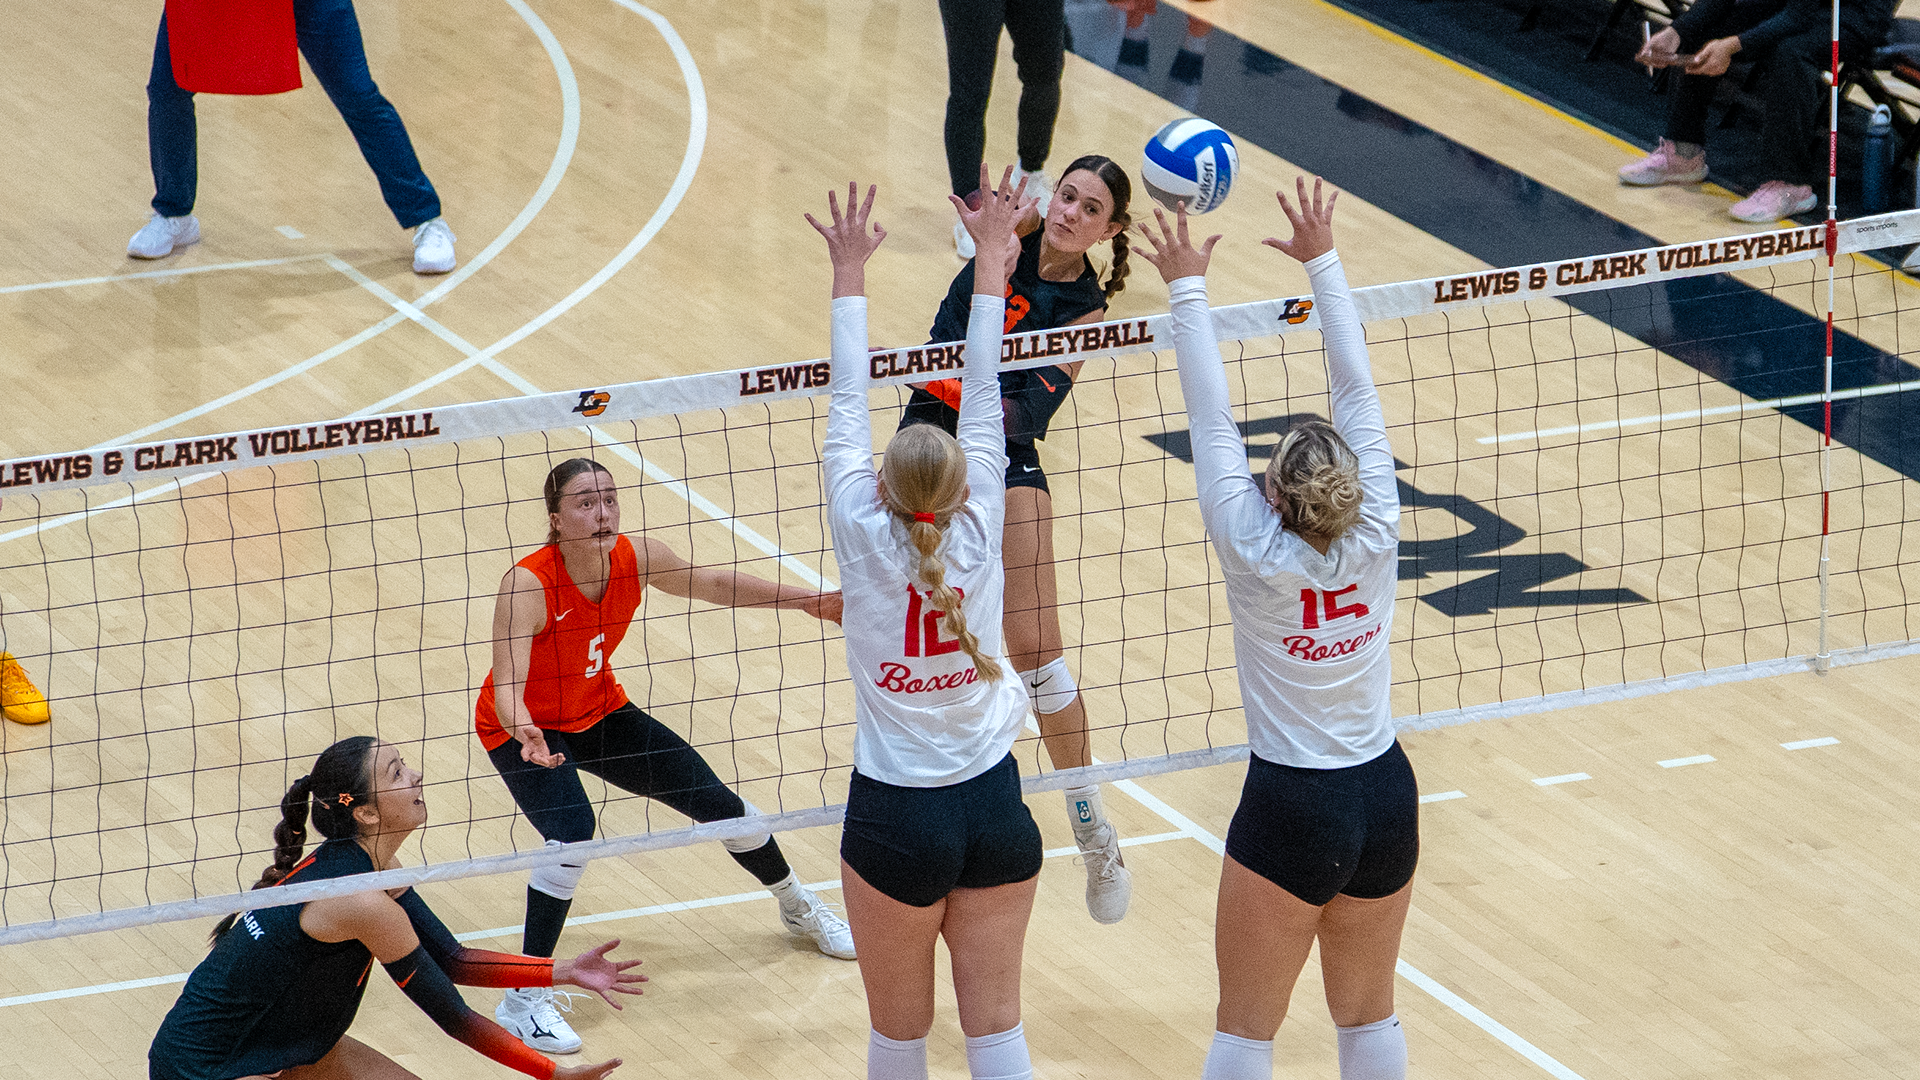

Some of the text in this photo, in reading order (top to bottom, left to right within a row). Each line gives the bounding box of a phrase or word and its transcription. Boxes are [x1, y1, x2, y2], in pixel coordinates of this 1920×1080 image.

[1195, 161, 1213, 210] molten
[1434, 227, 1824, 303] LEWIS & CLARK VOLLEYBALL
[740, 320, 1154, 396] LEWIS CLARK OLLEYBALL
[103, 450, 124, 476] &
[134, 436, 238, 472] CLARK
[248, 412, 440, 457] VOLLEYBALL
[585, 632, 605, 679] 5
[874, 662, 979, 694] Boxer
[243, 910, 265, 941] LARK
